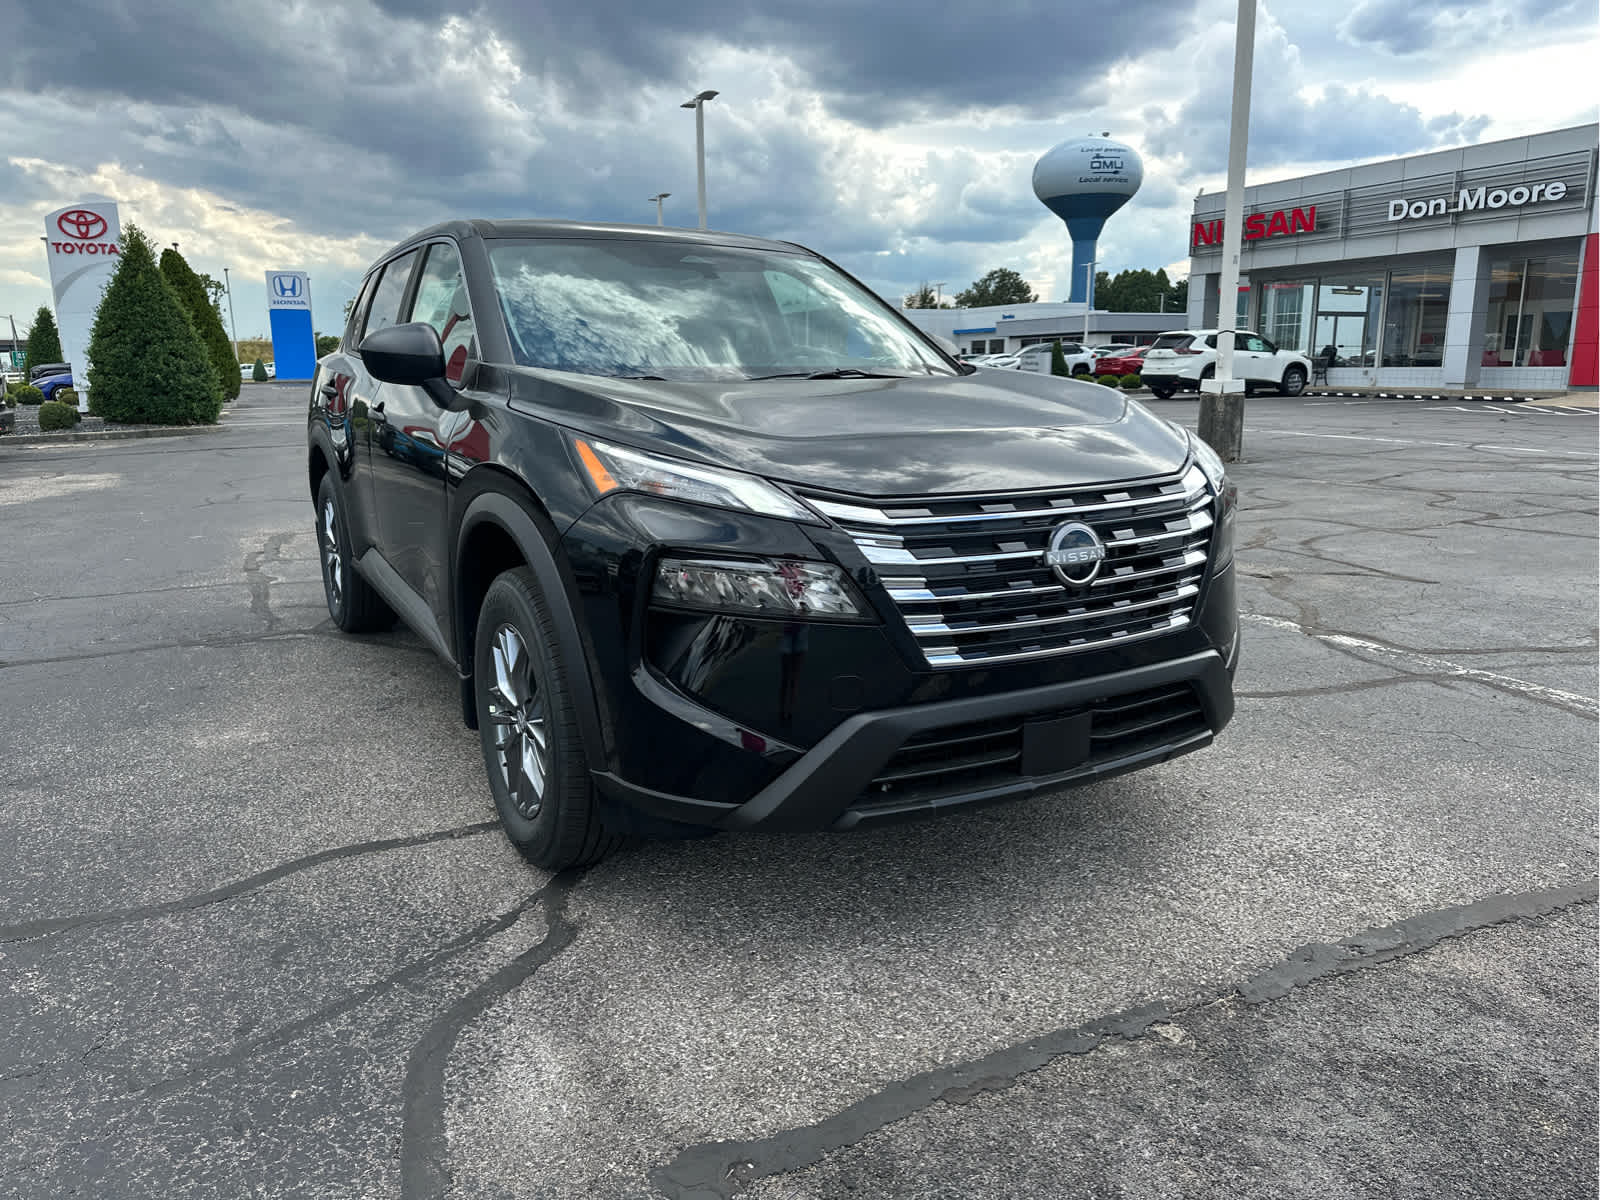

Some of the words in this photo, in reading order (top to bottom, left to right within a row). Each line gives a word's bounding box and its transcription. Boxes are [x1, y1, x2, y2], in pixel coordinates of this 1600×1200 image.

[1090, 160, 1124, 170] OMU
[1387, 198, 1447, 222] Don
[1457, 181, 1567, 212] Moore
[1193, 205, 1317, 246] NISAN
[51, 242, 120, 255] TOYOTA
[1047, 546, 1105, 564] NISSAN
